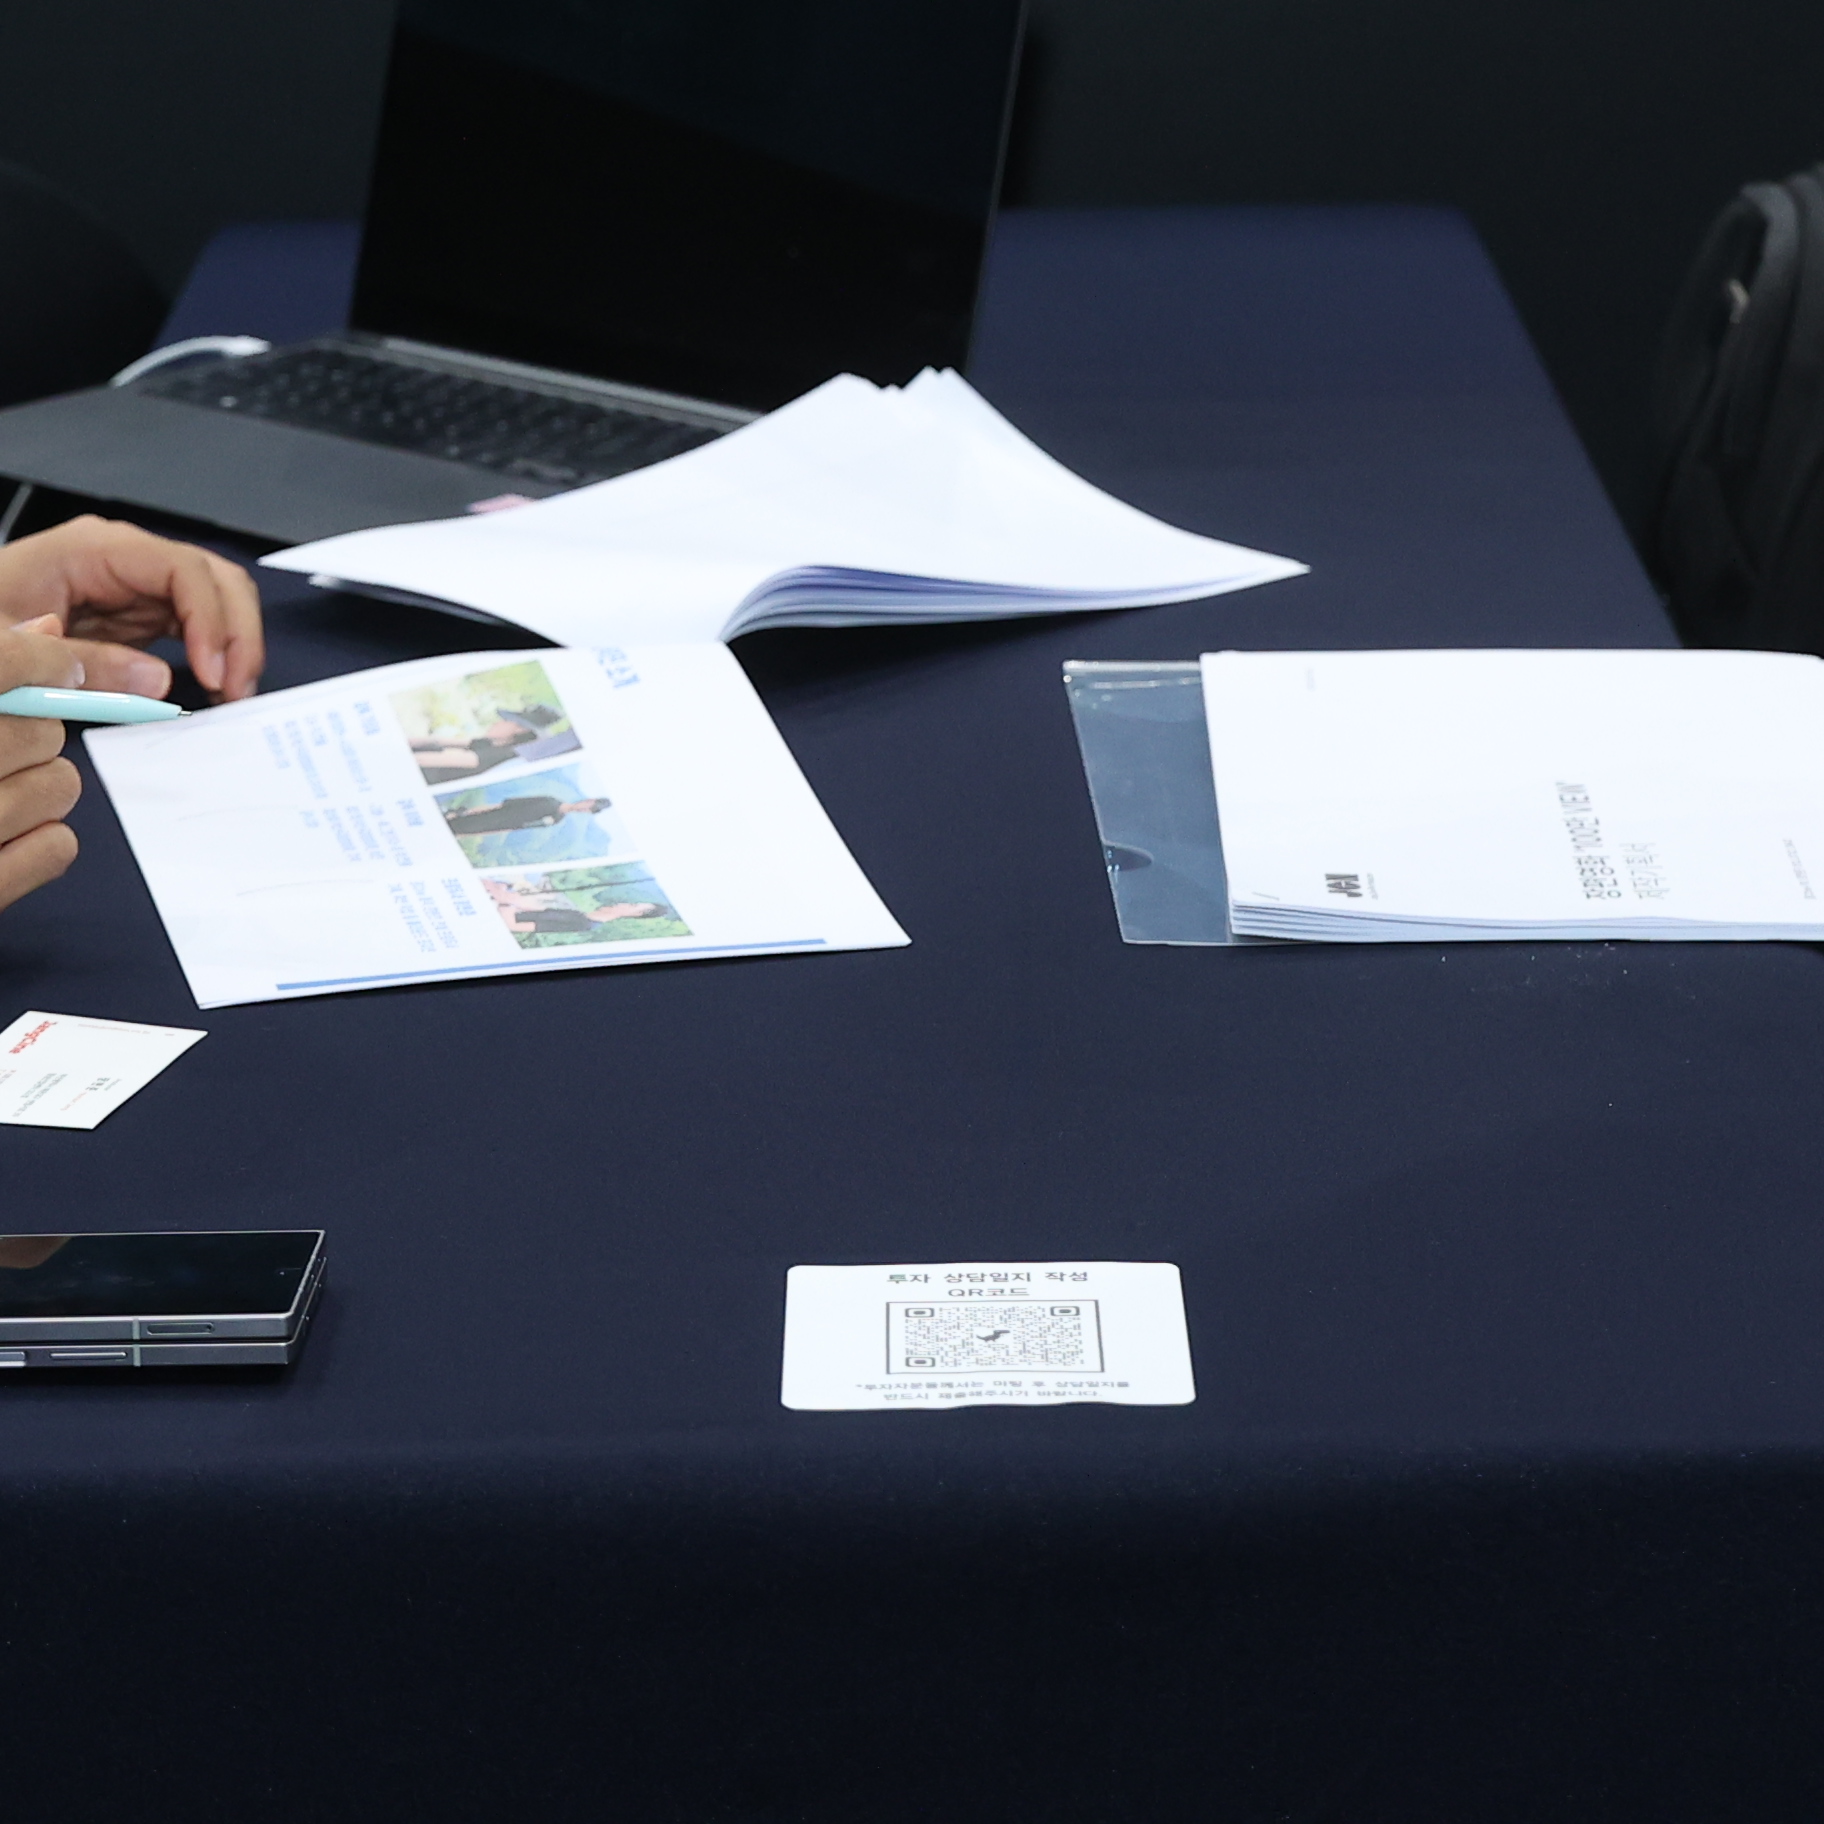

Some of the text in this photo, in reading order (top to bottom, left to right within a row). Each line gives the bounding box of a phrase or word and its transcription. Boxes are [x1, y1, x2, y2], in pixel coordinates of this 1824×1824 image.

[887, 1271, 1089, 1284] 투자 상담일지 작성
[948, 1287, 1031, 1297] QR코드
[1055, 1379, 1130, 1388] 상담일지를
[883, 1392, 930, 1401] 반드시
